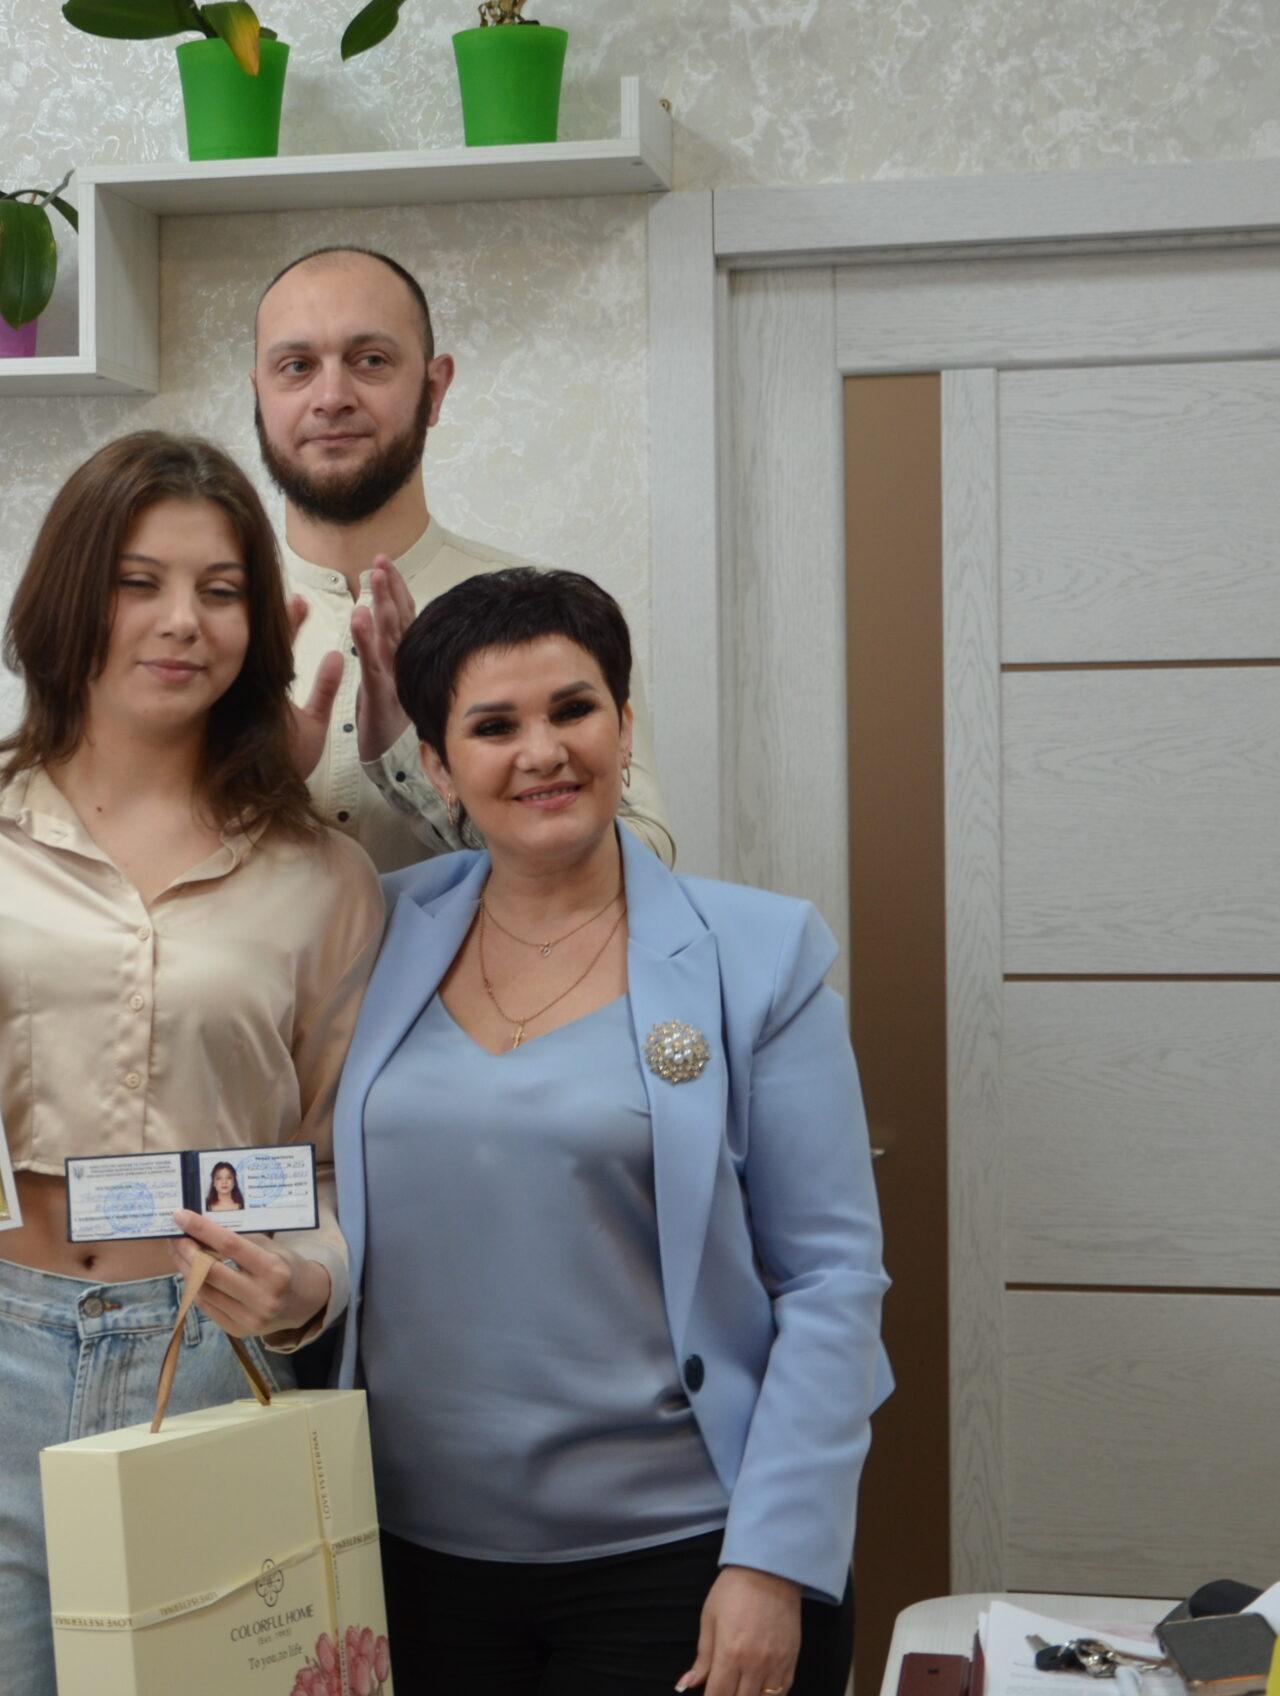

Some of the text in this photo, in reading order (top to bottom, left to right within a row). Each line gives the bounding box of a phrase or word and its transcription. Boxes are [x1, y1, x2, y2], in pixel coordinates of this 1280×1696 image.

[312, 1430, 325, 1478] ETERNAL
[321, 1494, 332, 1520] LOVE
[106, 1618, 133, 1627] LOVE
[230, 1604, 315, 1642] COLORFUL HOME
